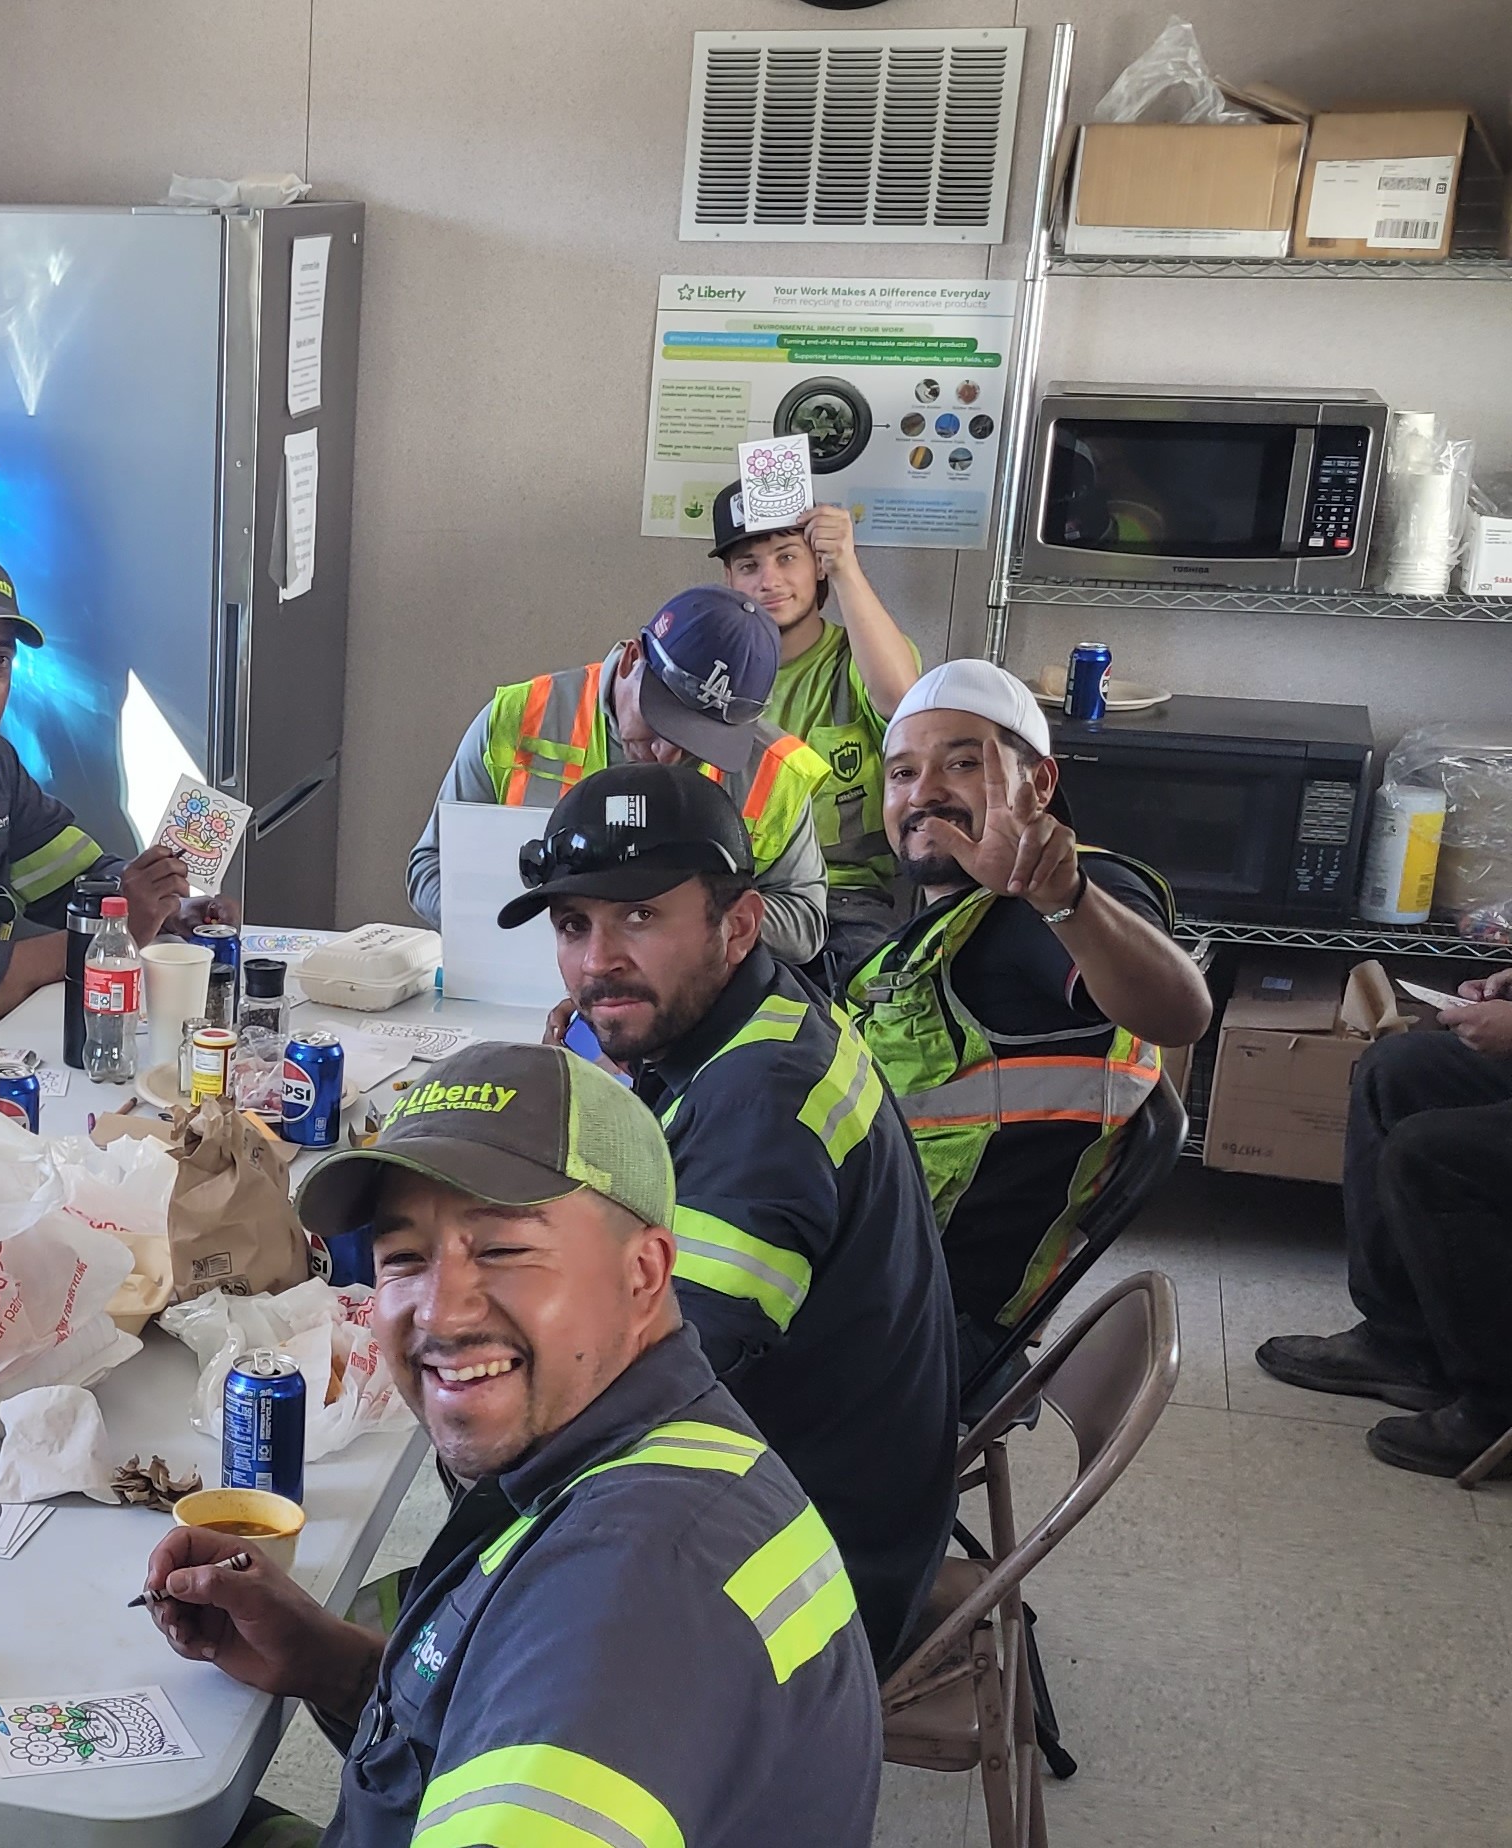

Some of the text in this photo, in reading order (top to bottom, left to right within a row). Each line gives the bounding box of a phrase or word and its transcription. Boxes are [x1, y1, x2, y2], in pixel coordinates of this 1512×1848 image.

[697, 285, 746, 302] Liberty
[774, 286, 991, 300] Your Work Makes A Difference Everyday
[772, 297, 987, 310] From recycling to creating innovative products
[753, 324, 815, 332] ENVIRONMENTAL
[783, 338, 806, 346] Turning
[807, 338, 839, 346] end-of-life
[794, 352, 827, 361] Supporting
[1173, 566, 1210, 574] TOSHIBA
[697, 659, 733, 709] LA
[406, 1080, 516, 1113] Liberty
[422, 1102, 493, 1113] RECYCLING
